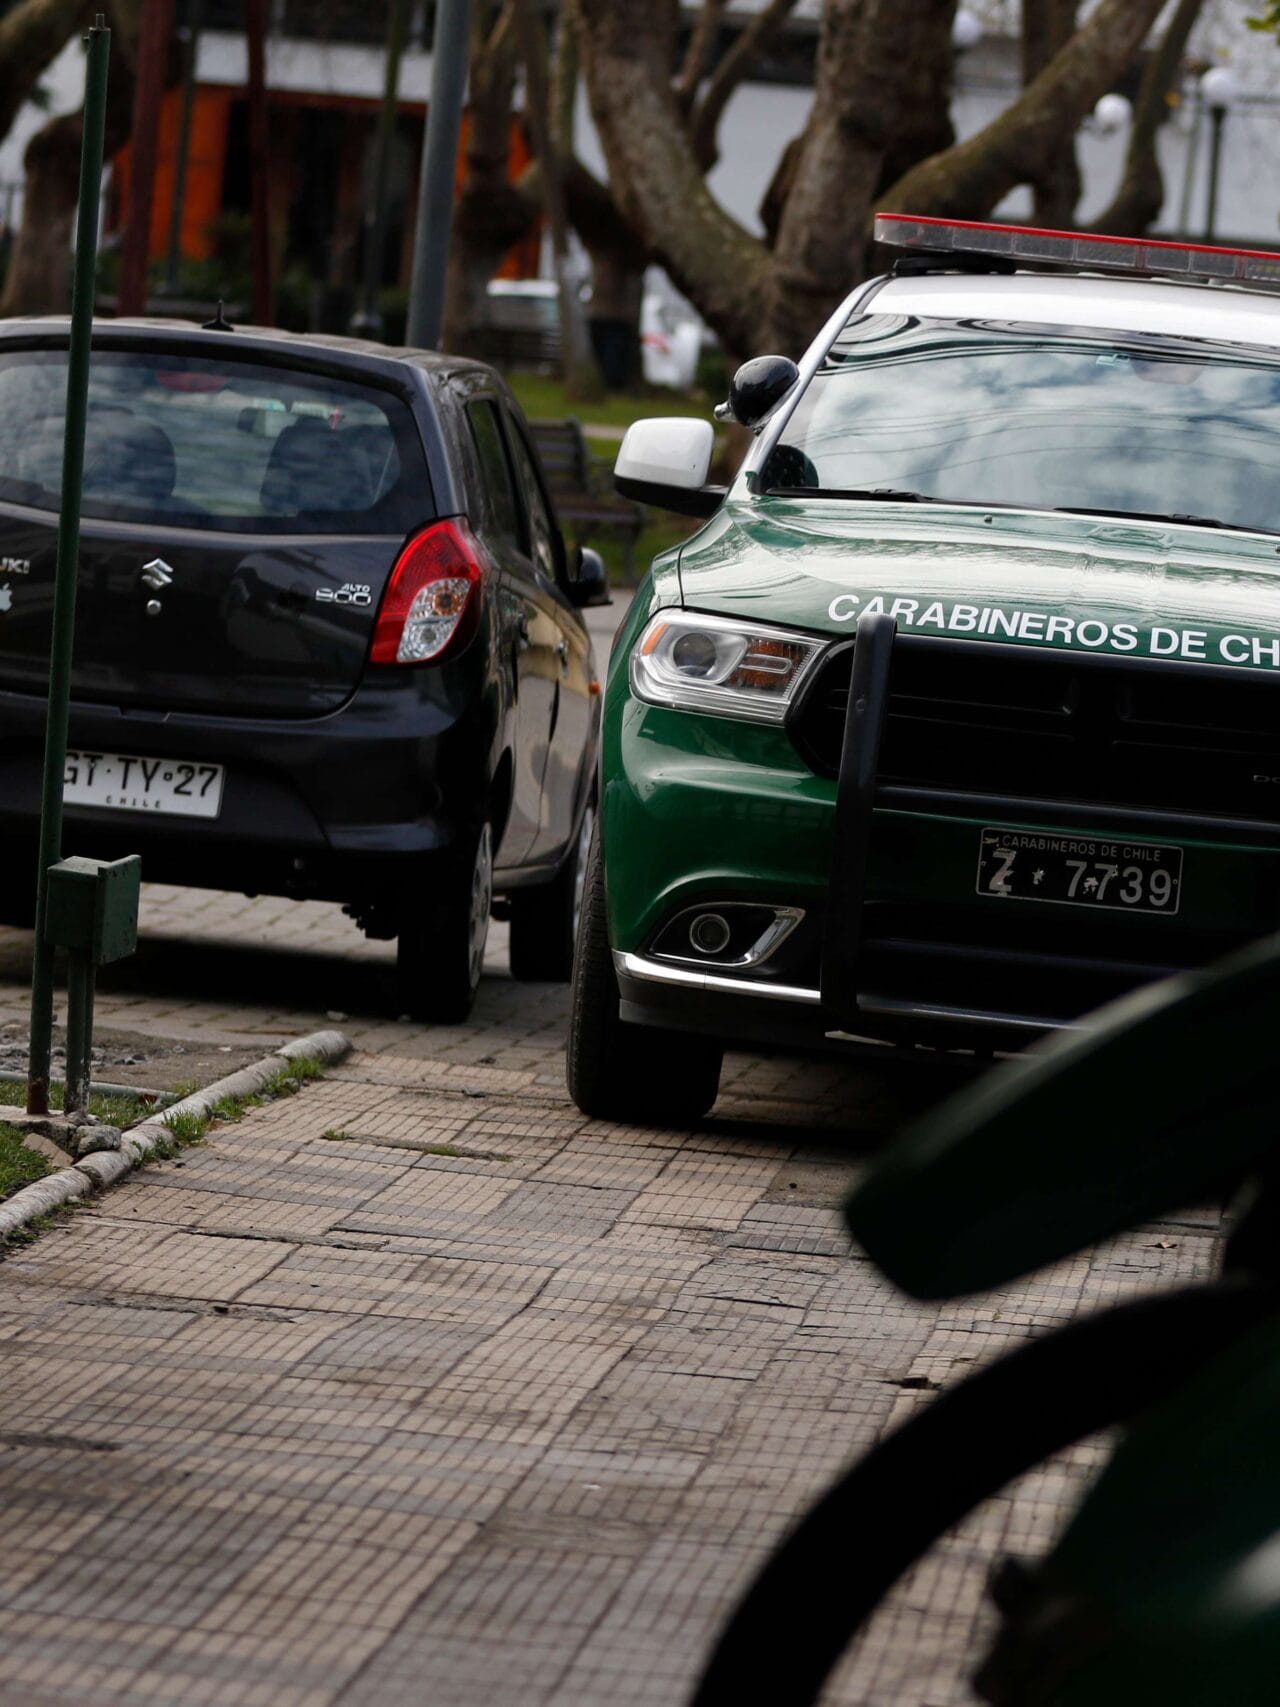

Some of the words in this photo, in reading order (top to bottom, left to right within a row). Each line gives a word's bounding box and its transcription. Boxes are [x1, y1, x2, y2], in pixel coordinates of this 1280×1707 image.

[315, 587, 372, 606] 800
[341, 583, 371, 593] ALTO
[828, 594, 1138, 651] CARABINEROS
[1150, 627, 1208, 659] DE
[106, 795, 161, 809] CHILE
[1002, 834, 1096, 856] CARABINEROS
[1101, 846, 1118, 858] DE
[1123, 847, 1161, 862] CHILE
[1065, 859, 1172, 906] 7739
